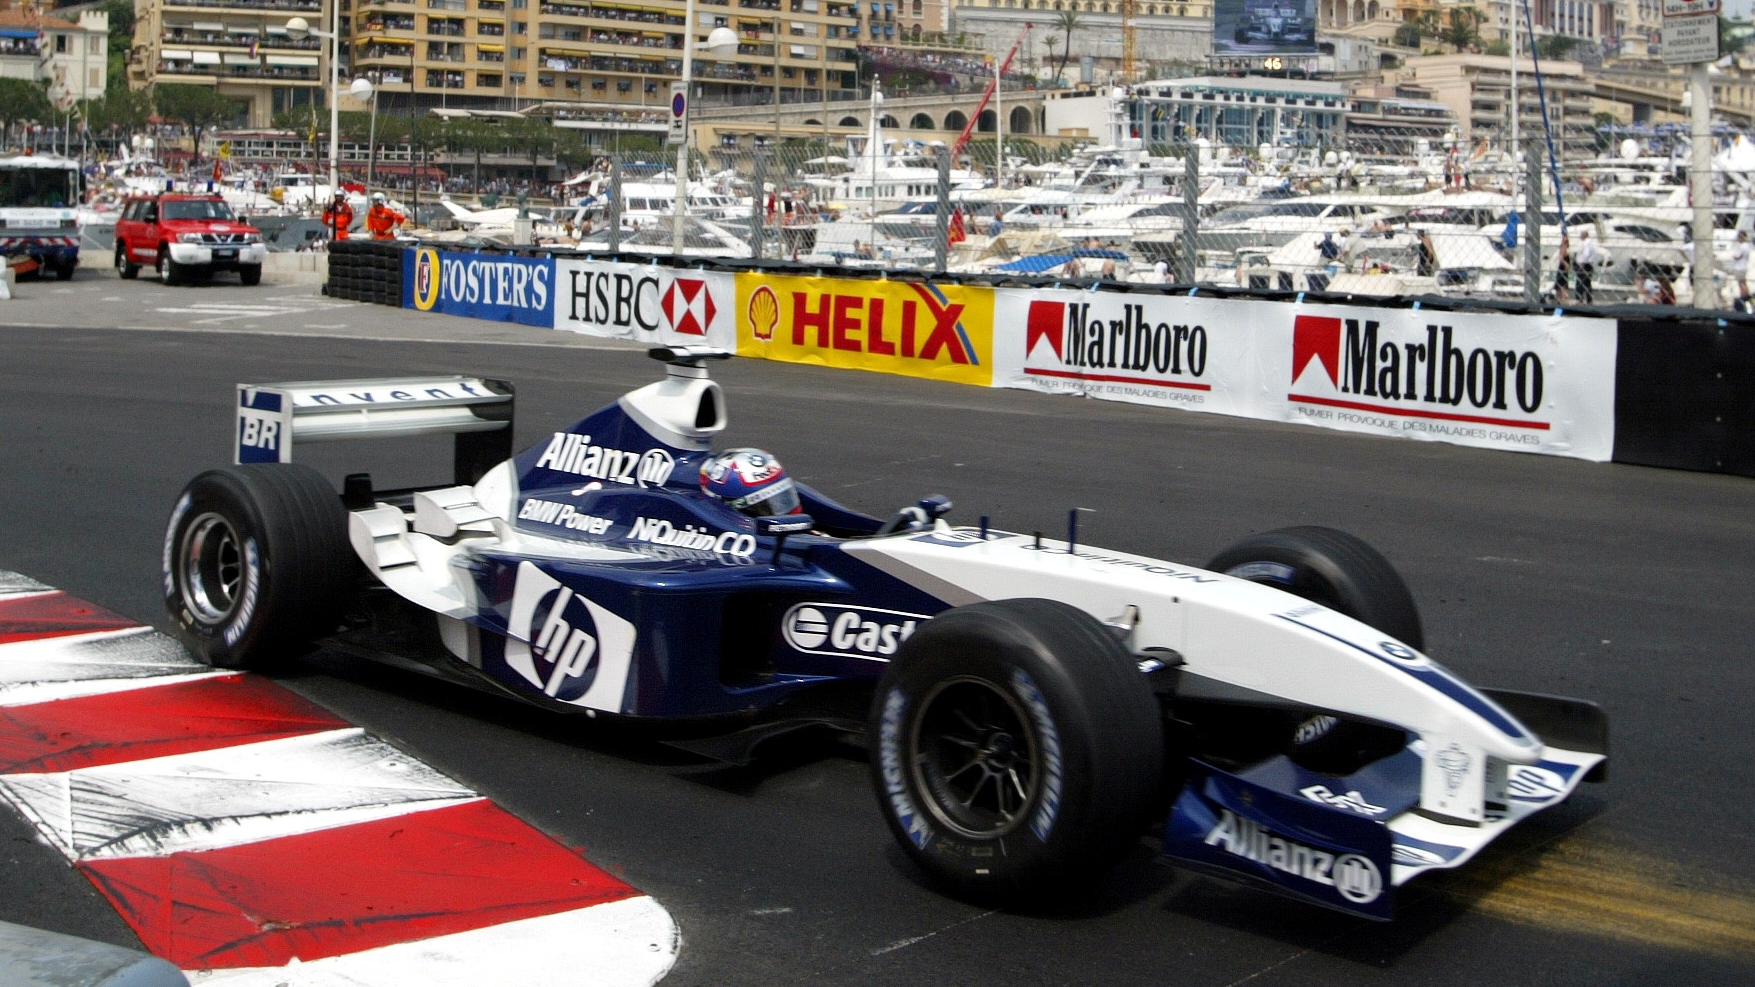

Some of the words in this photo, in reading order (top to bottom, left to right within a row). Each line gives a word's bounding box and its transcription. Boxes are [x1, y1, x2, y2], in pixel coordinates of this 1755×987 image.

[1264, 57, 1281, 70] 46
[440, 258, 549, 311] FOSTER'S
[568, 269, 660, 332] HSBC
[792, 282, 971, 364] HELIX
[1065, 302, 1207, 377] Marlboro
[1341, 318, 1544, 413] Marlboro
[294, 383, 481, 406] nvent
[242, 417, 278, 450] BR
[1298, 406, 1332, 419] FUMER
[1338, 412, 1398, 429] PROVOQUE
[1402, 421, 1426, 430] DES
[1428, 423, 1487, 439] MALADIES
[1489, 430, 1540, 445] GRAVES
[536, 431, 640, 485] Allianz
[518, 498, 563, 524] BMW
[558, 504, 614, 535] Power
[534, 584, 597, 698] hp
[1204, 808, 1336, 887] Allianz
